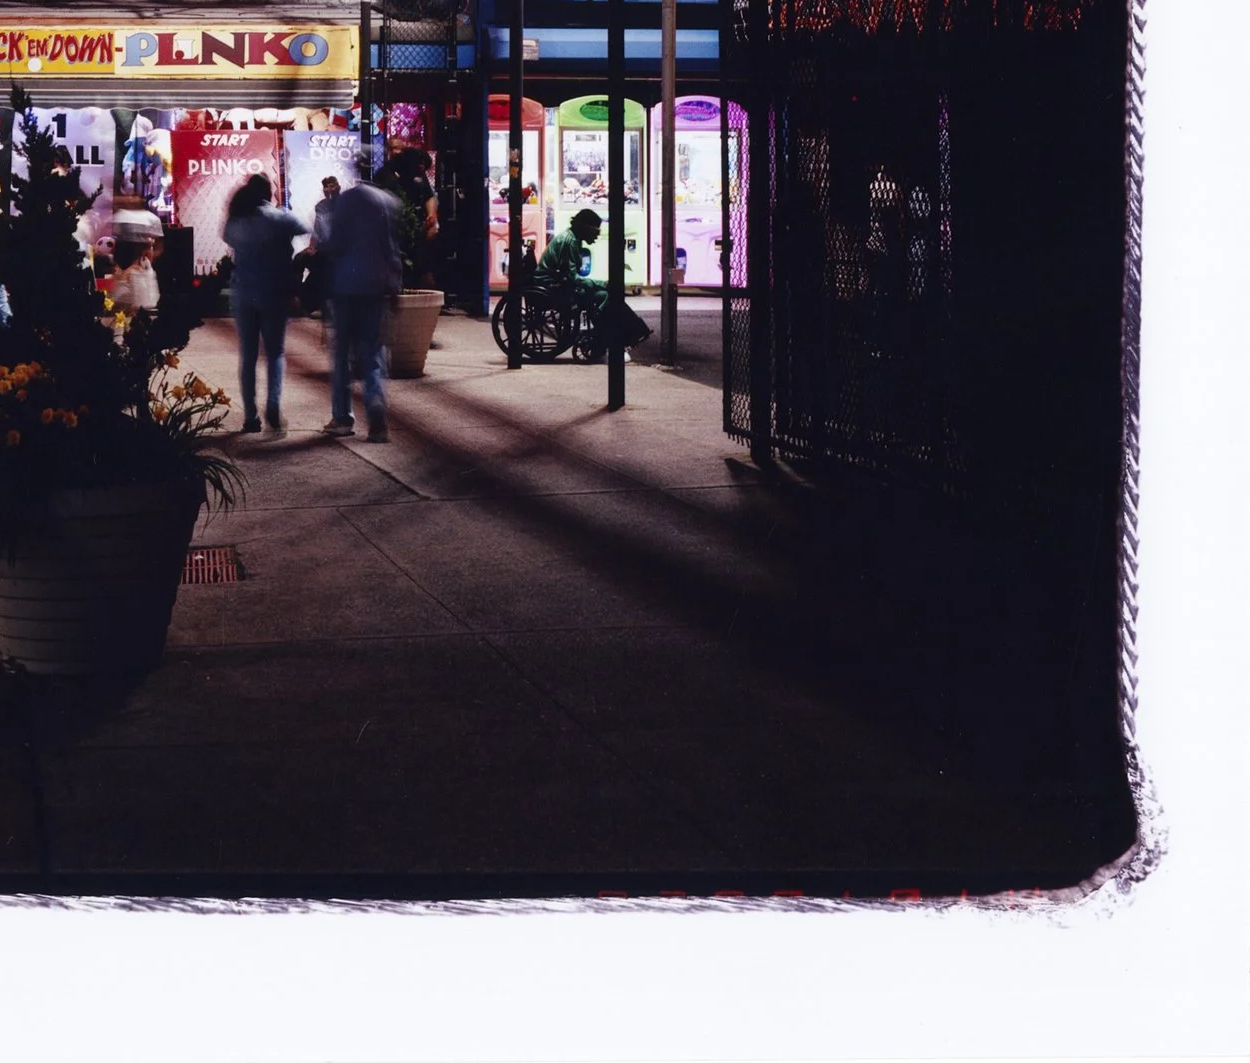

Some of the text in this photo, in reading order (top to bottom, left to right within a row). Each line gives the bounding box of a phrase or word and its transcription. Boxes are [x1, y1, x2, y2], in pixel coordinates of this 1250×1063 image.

[48, 32, 114, 64] DOWN
[51, 113, 67, 138] 1
[200, 133, 250, 147] START
[308, 134, 358, 149] START
[187, 158, 265, 176] PLINKO
